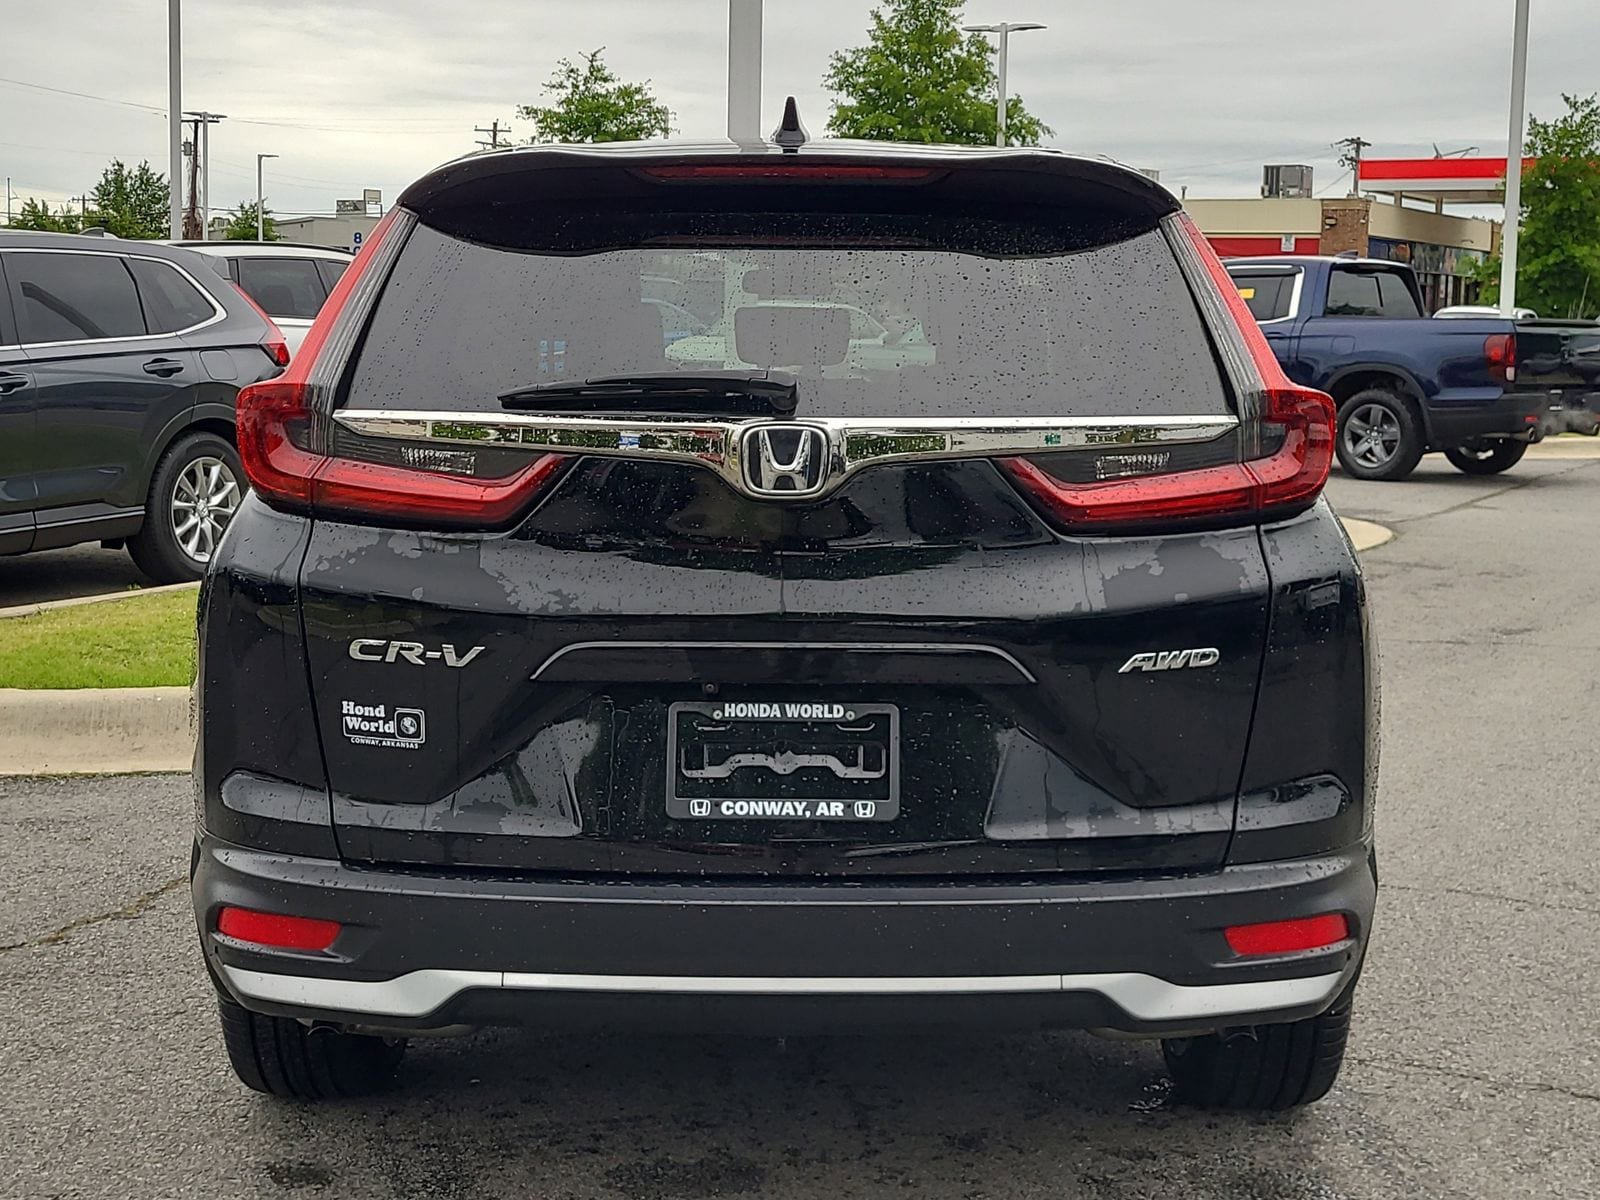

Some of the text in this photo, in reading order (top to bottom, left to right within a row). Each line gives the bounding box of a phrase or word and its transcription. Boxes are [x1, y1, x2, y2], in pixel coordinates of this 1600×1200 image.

[349, 639, 486, 667] CR-V
[1118, 647, 1220, 673] AWD
[342, 701, 386, 718] Hond
[724, 703, 845, 719] HONDA WORLD
[345, 716, 395, 734] World
[350, 737, 419, 749] CONWAY, ARKANSAS
[720, 801, 812, 818] CONWAY,
[815, 803, 844, 816] AR
